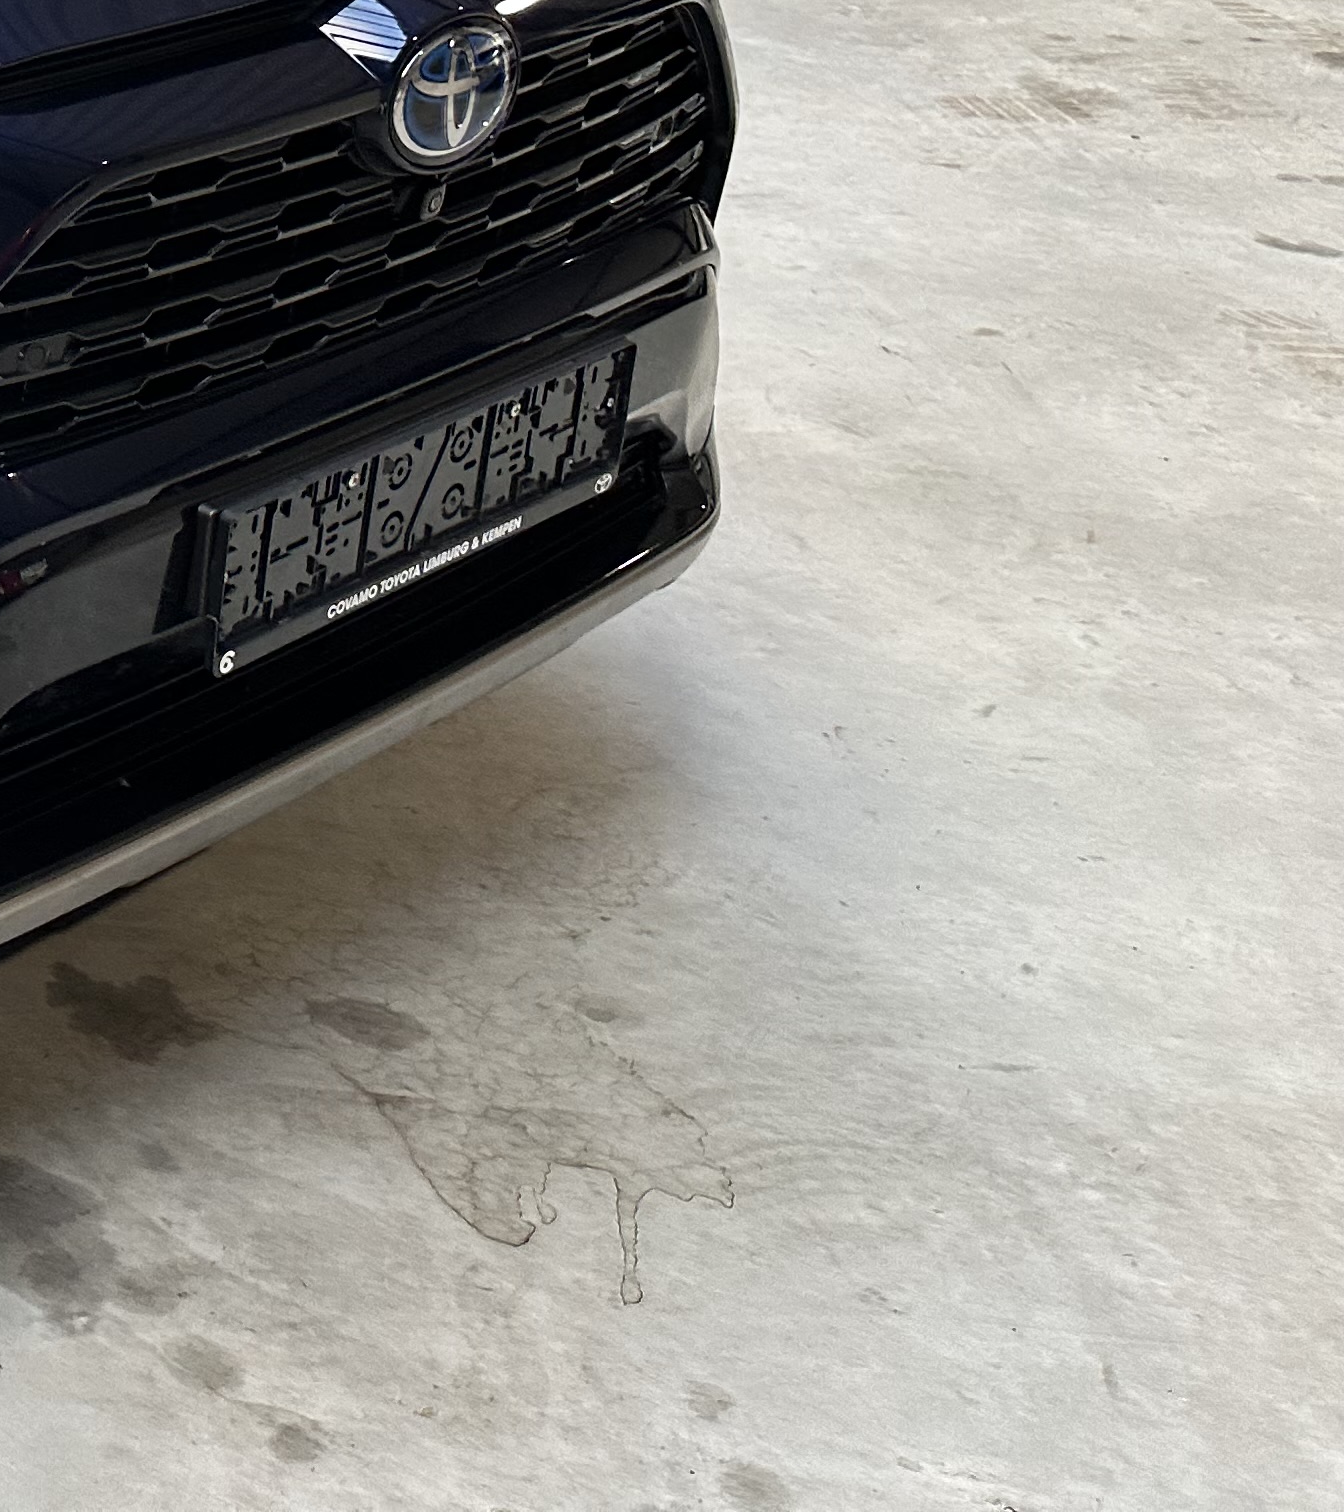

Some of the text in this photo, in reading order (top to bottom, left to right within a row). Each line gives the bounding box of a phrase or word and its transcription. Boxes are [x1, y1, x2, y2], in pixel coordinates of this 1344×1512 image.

[327, 515, 523, 619] COVAMO TOYOTA LIMBURG & KEMPEN
